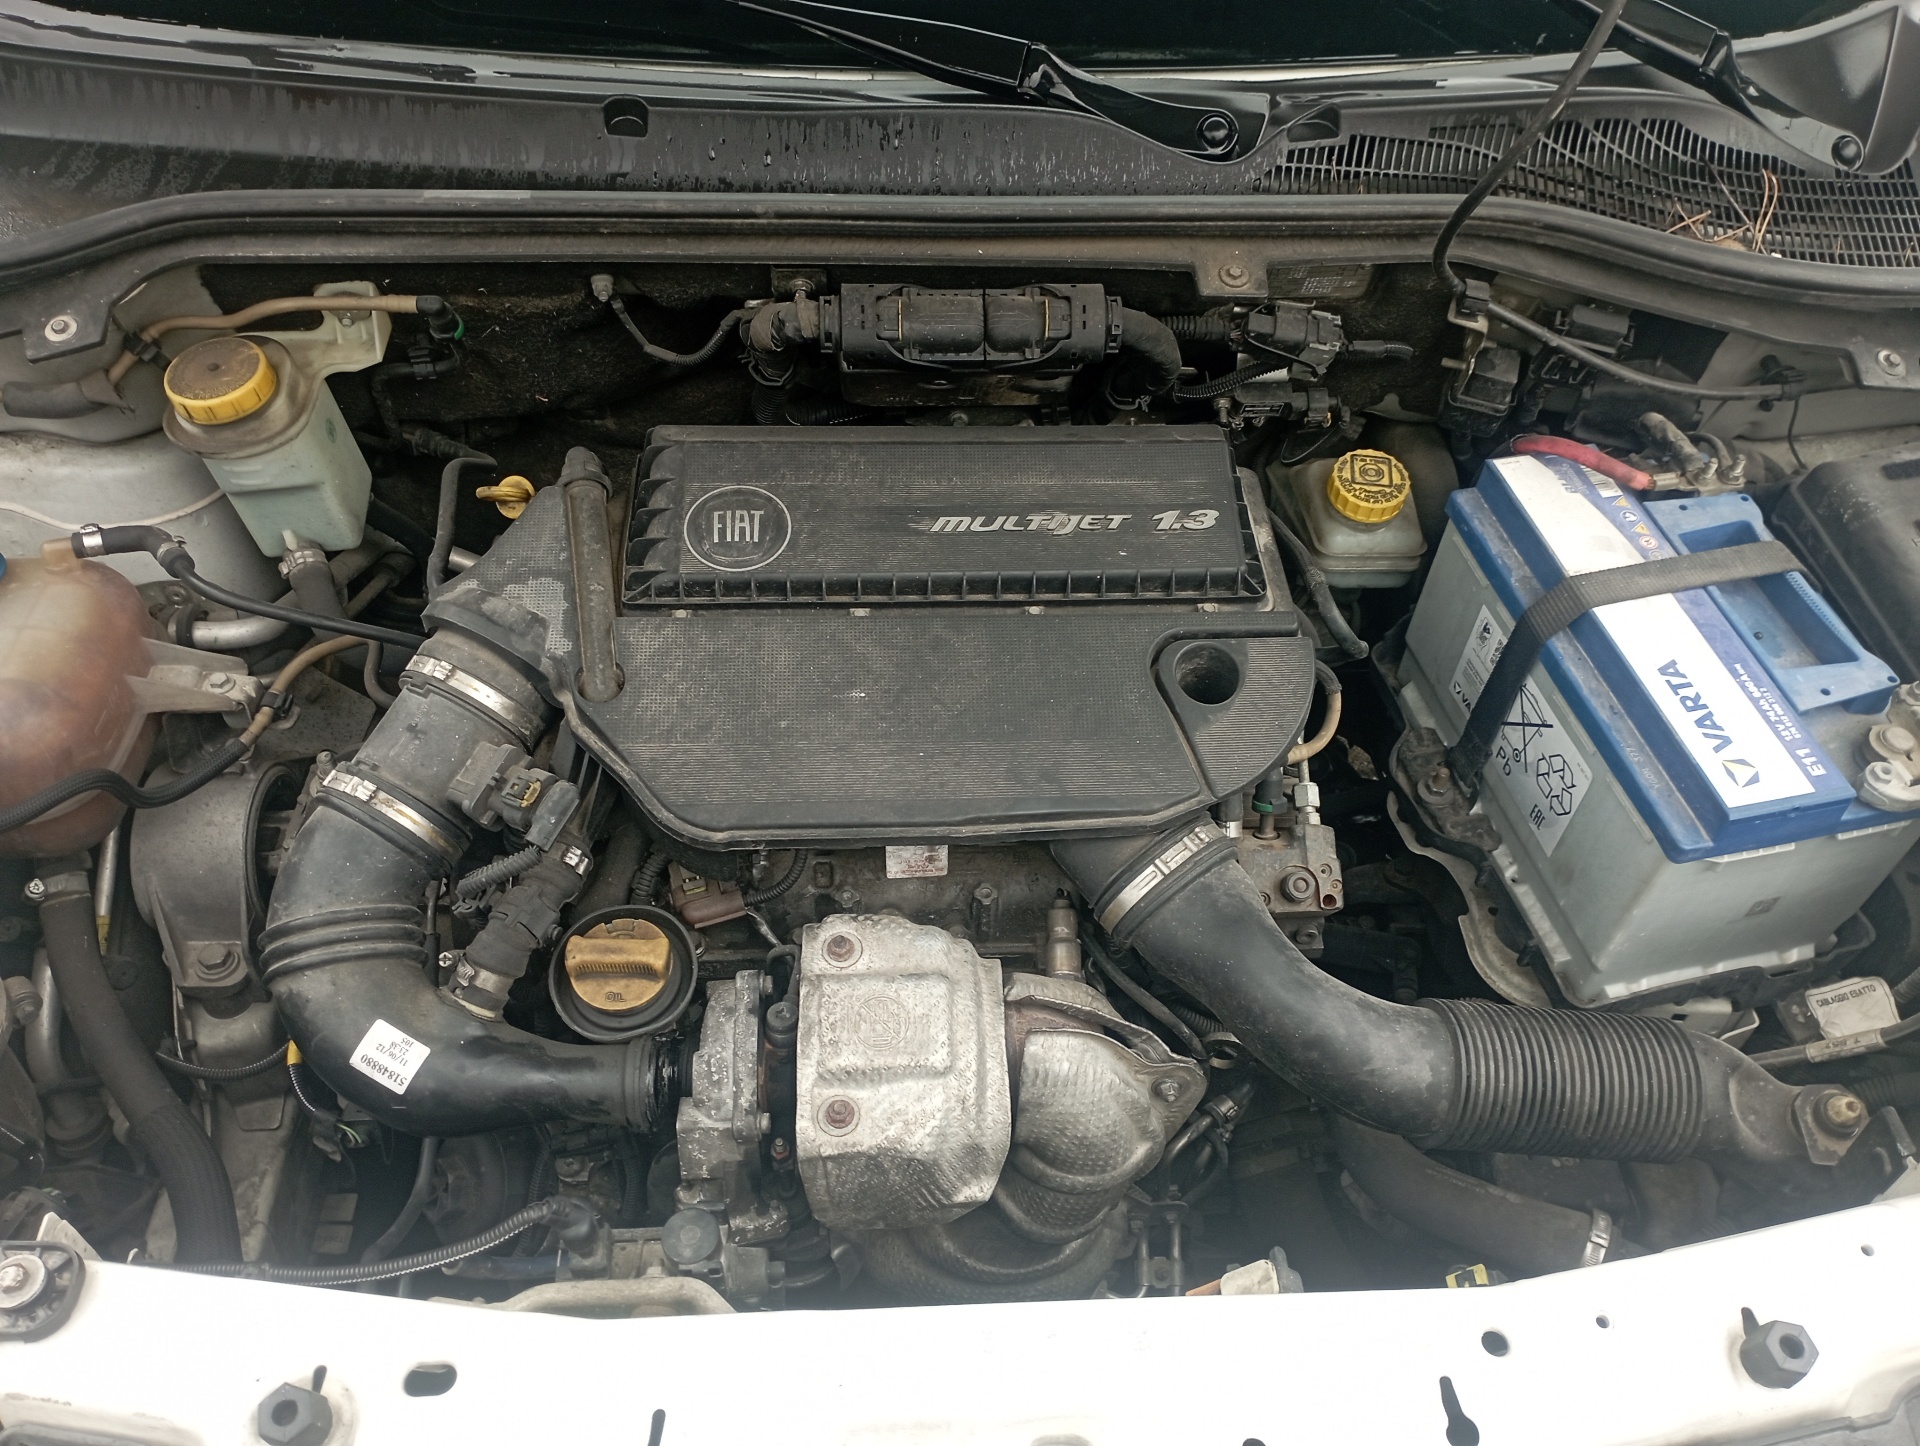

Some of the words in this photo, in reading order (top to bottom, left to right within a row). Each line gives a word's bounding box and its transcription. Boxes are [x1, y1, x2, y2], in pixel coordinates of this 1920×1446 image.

[713, 509, 764, 543] FIAT
[1152, 509, 1219, 531] 1.3
[1657, 659, 1733, 754] VARTA
[1495, 746, 1512, 777] Pb
[1795, 748, 1827, 777] E11
[1529, 803, 1546, 830] EAC
[605, 991, 626, 1002] OIL
[1849, 984, 1877, 998] ESATTO
[376, 1043, 408, 1067] 11/06/12
[400, 1037, 415, 1048] 105
[360, 1053, 408, 1086] 51848880
